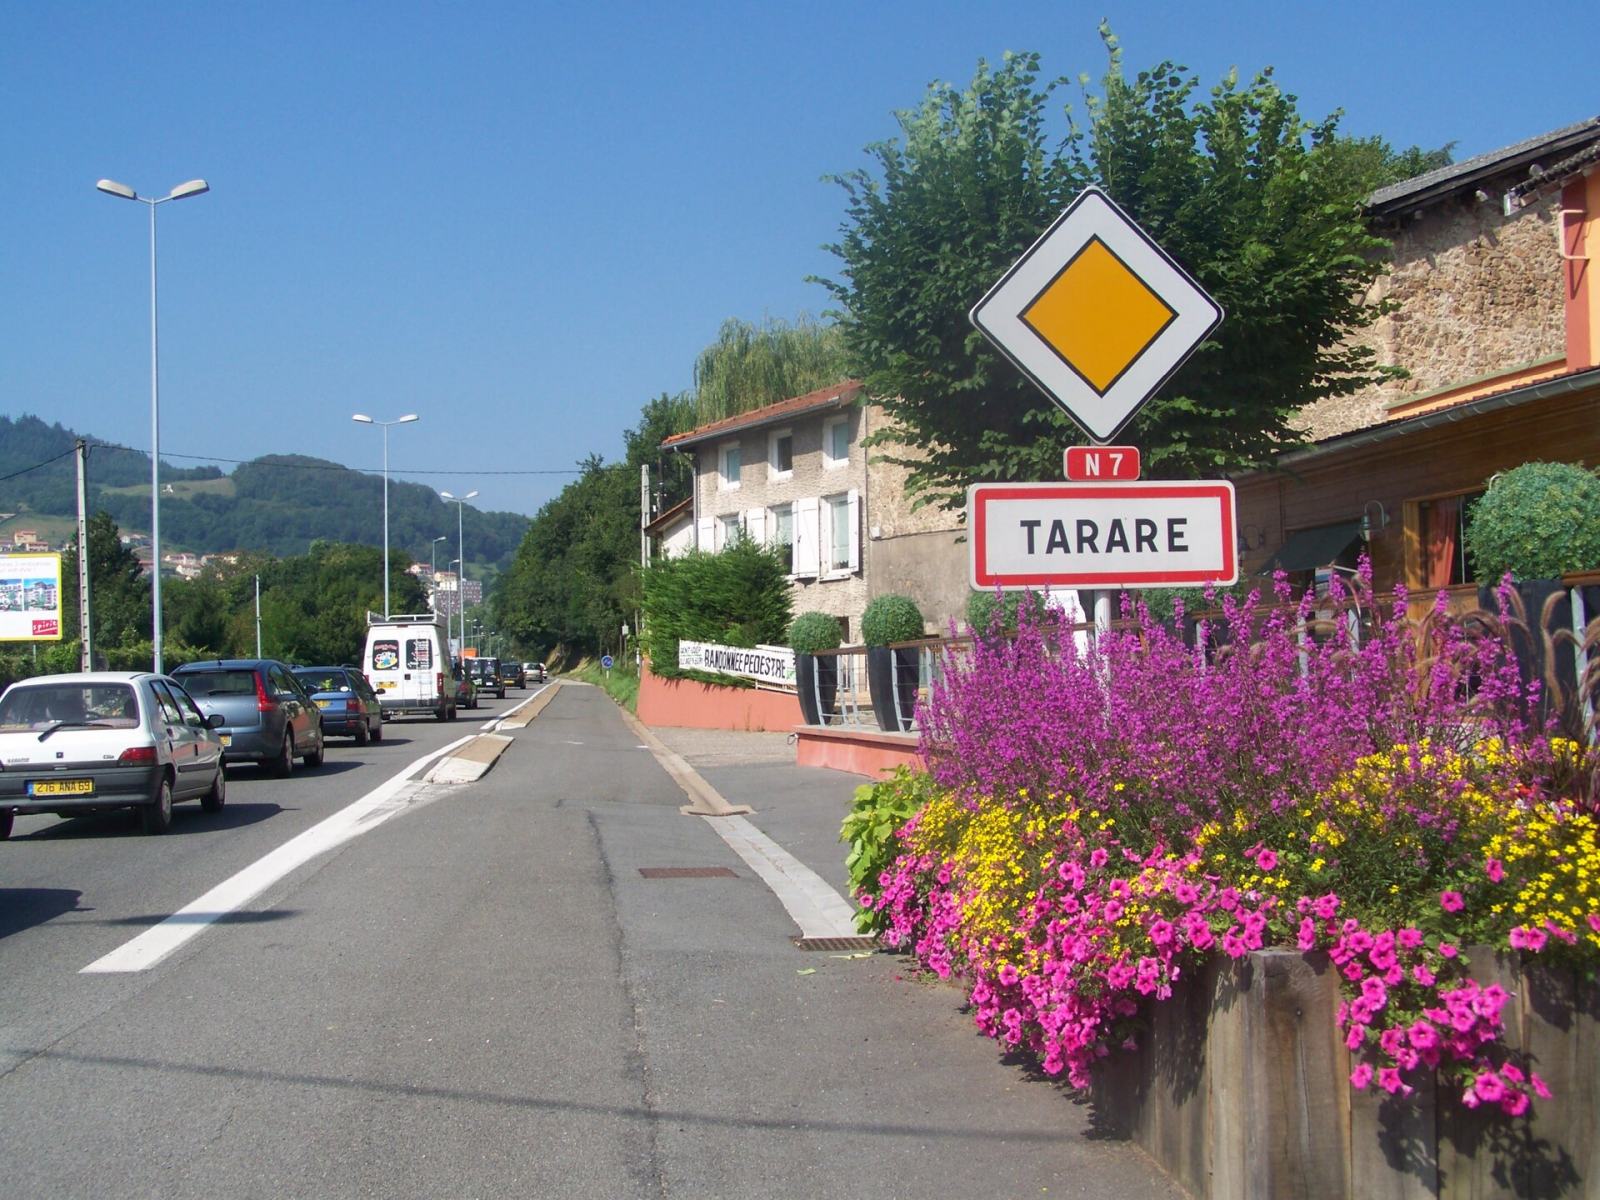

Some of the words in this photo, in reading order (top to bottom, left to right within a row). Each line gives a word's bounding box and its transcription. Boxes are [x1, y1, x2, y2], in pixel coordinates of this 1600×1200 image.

[1085, 453, 1099, 476] N
[1109, 453, 1124, 476] 7
[1019, 517, 1189, 555] TARARE
[33, 620, 58, 631] spirit
[743, 653, 786, 679] PEDESTRE
[37, 783, 55, 792] 276
[59, 782, 76, 791] ANA
[78, 781, 90, 790] 69
